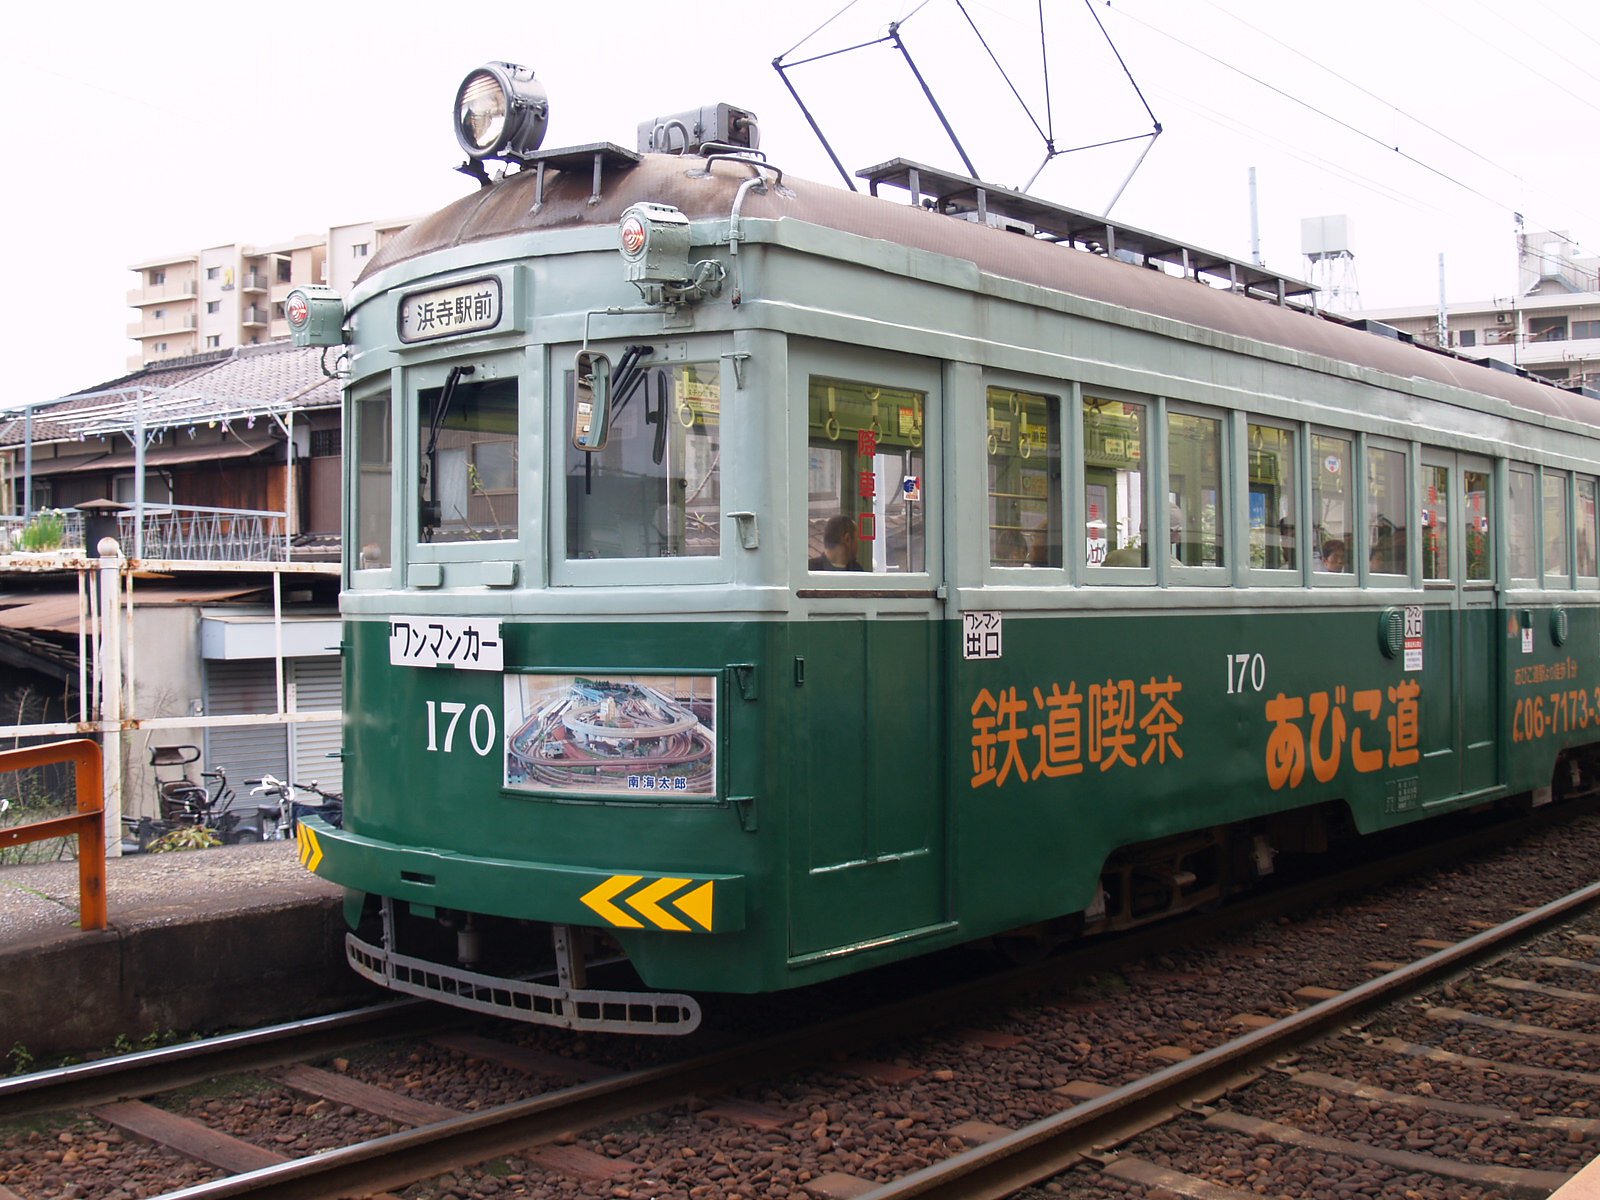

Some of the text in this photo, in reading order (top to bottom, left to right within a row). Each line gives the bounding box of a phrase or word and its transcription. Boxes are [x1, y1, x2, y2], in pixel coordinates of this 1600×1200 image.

[417, 291, 492, 332] 浜寺駅前
[858, 429, 876, 541] 降車口
[393, 622, 498, 661] ワンマンカー
[965, 613, 1000, 630] ワンマン
[1405, 619, 1421, 636] 入口
[966, 632, 1000, 657] 出口
[1226, 653, 1266, 694] 170
[426, 700, 497, 757] 170
[971, 675, 1421, 791] 鉄道喫茶 あびこ道
[627, 775, 687, 790] 南海太郎
